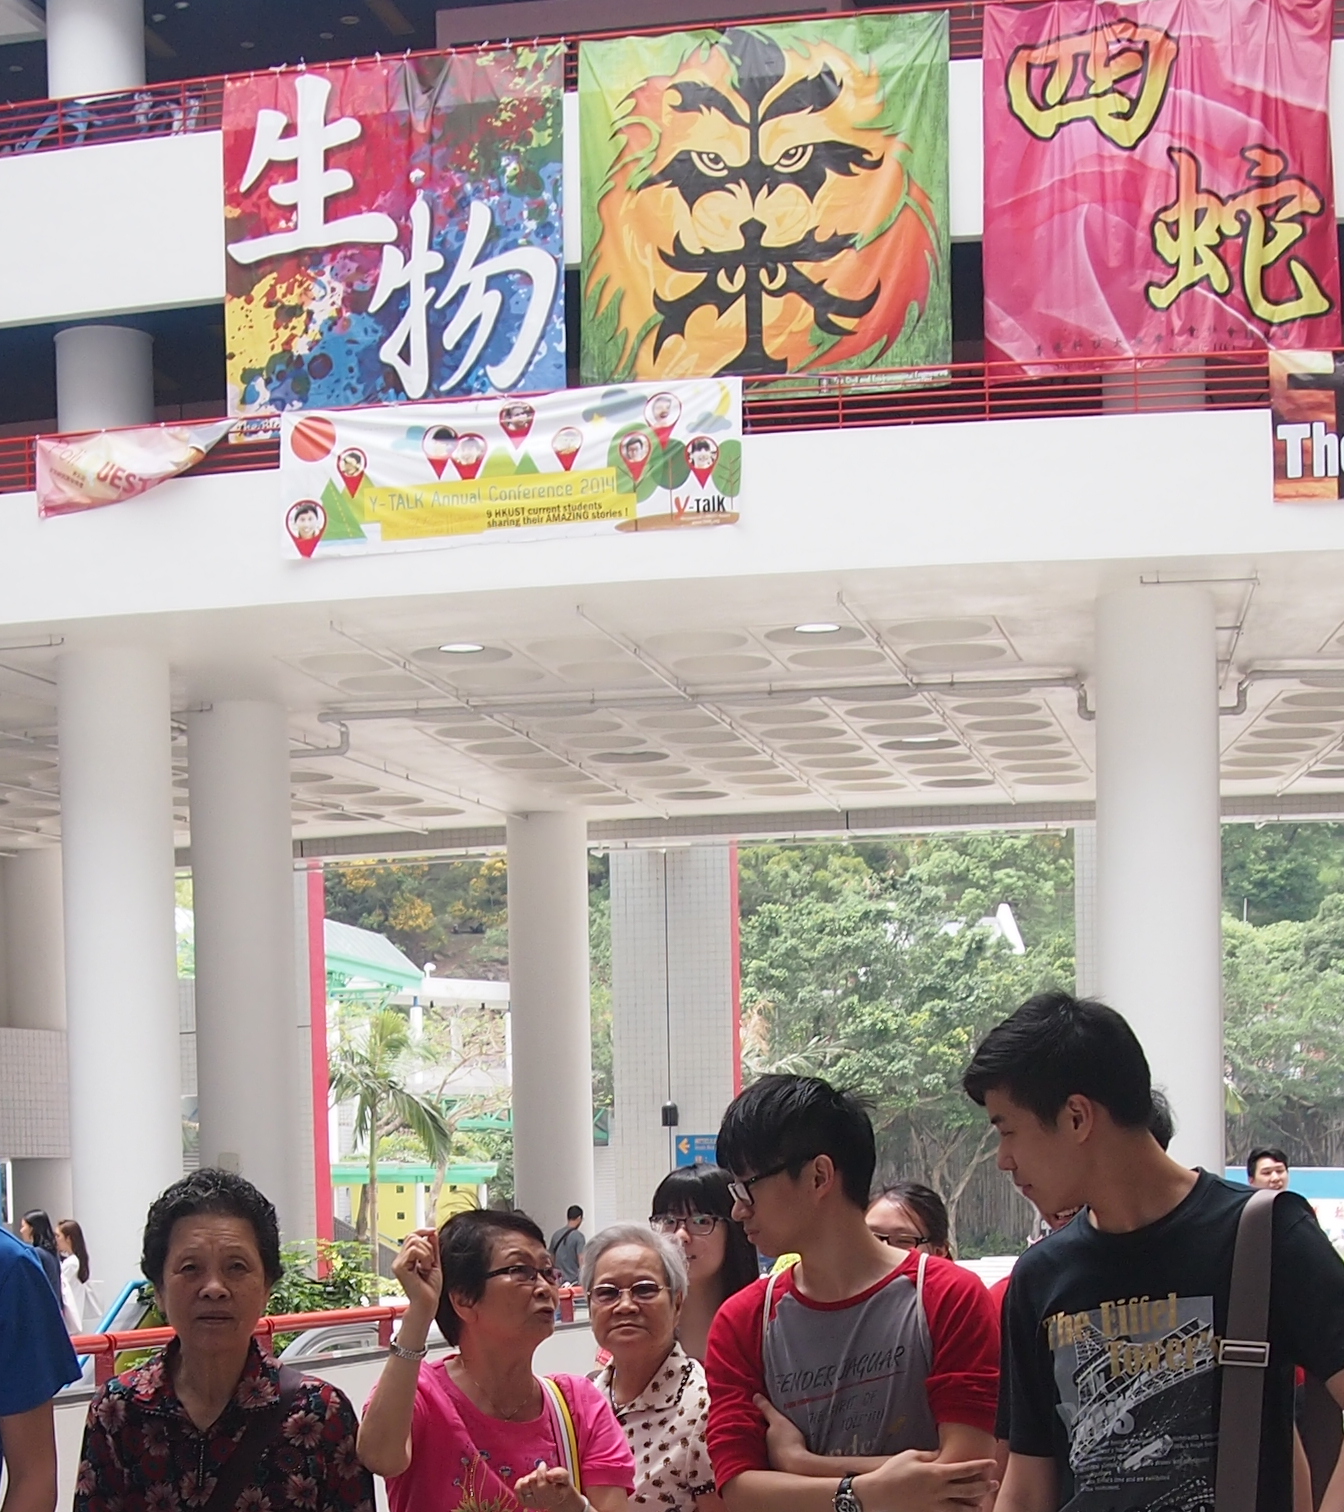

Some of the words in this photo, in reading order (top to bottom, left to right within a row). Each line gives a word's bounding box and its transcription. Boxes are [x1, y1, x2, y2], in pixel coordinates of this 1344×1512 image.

[227, 73, 559, 400] 生物
[431, 487, 482, 507] Annual
[488, 483, 573, 503] Conference
[580, 475, 615, 494] 2014
[487, 518, 521, 528] sharing
[523, 514, 544, 525] their
[546, 510, 589, 522] AMAZING
[592, 508, 622, 519] stories
[495, 507, 525, 518] HKUST
[528, 504, 560, 515] current
[563, 501, 602, 512] students
[1042, 1310, 1091, 1351] The
[1099, 1292, 1178, 1338] Eiffel
[837, 1345, 905, 1380] JAGUAR
